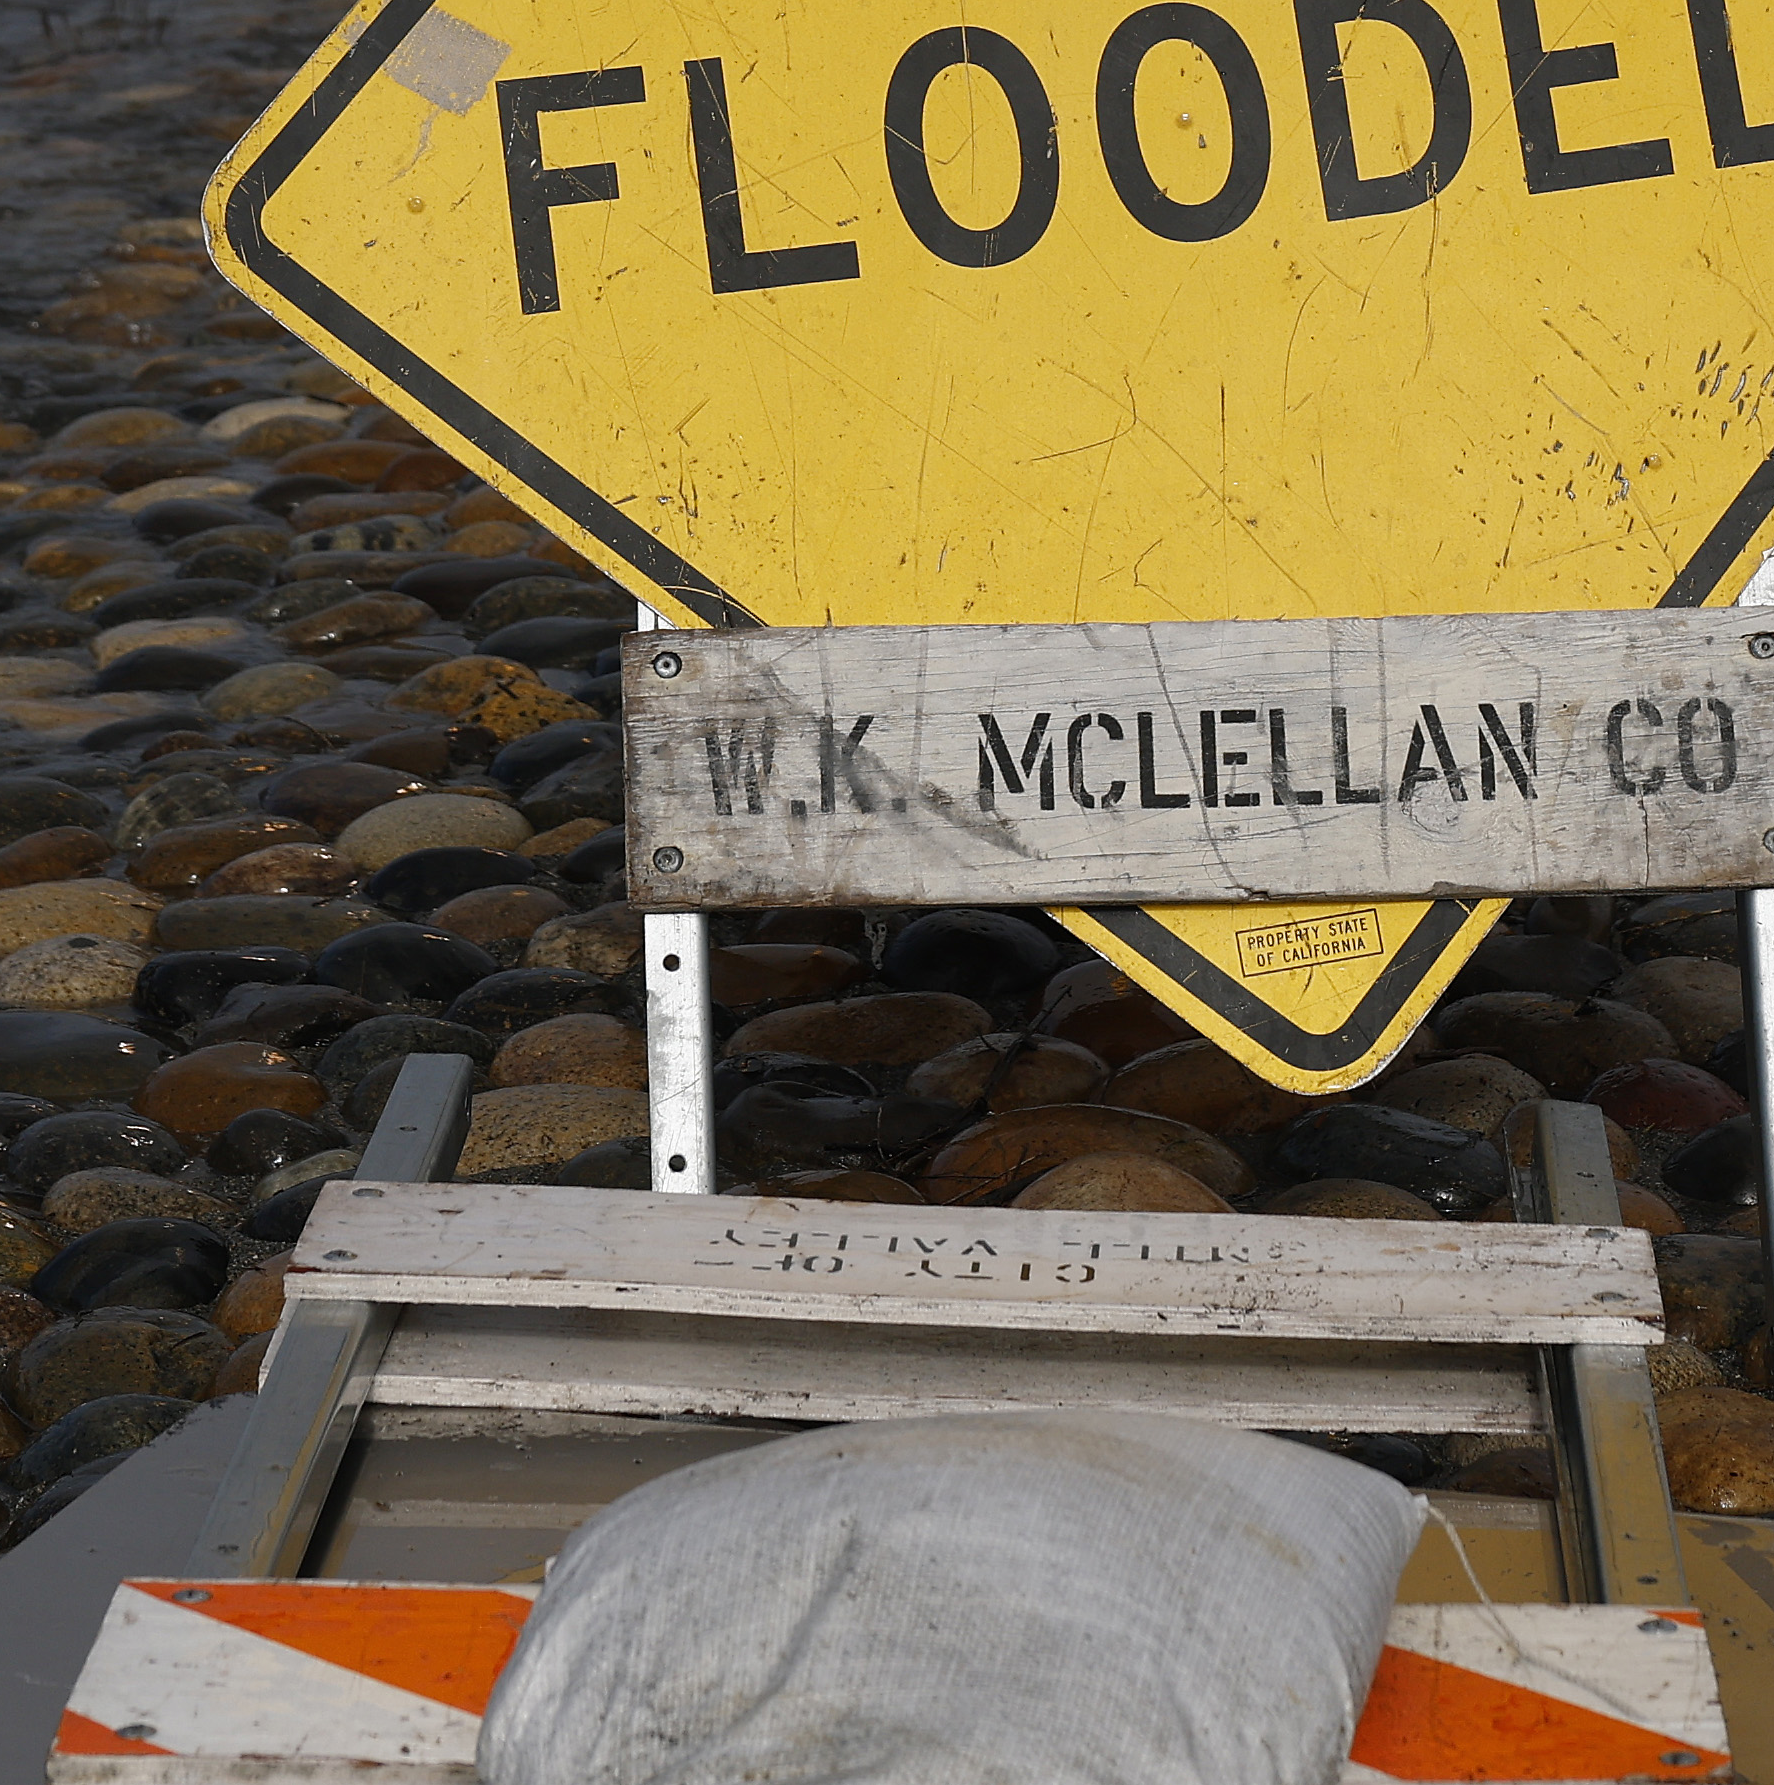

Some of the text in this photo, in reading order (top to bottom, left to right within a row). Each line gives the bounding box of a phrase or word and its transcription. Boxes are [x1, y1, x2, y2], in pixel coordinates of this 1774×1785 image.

[978, 701, 1538, 811] MCLELLAN
[1606, 697, 1737, 797] CO
[1247, 917, 1369, 951] PROPERTY STATE
[1256, 936, 1366, 967] OF CALIFORNIA
[904, 1259, 1096, 1282] CITY
